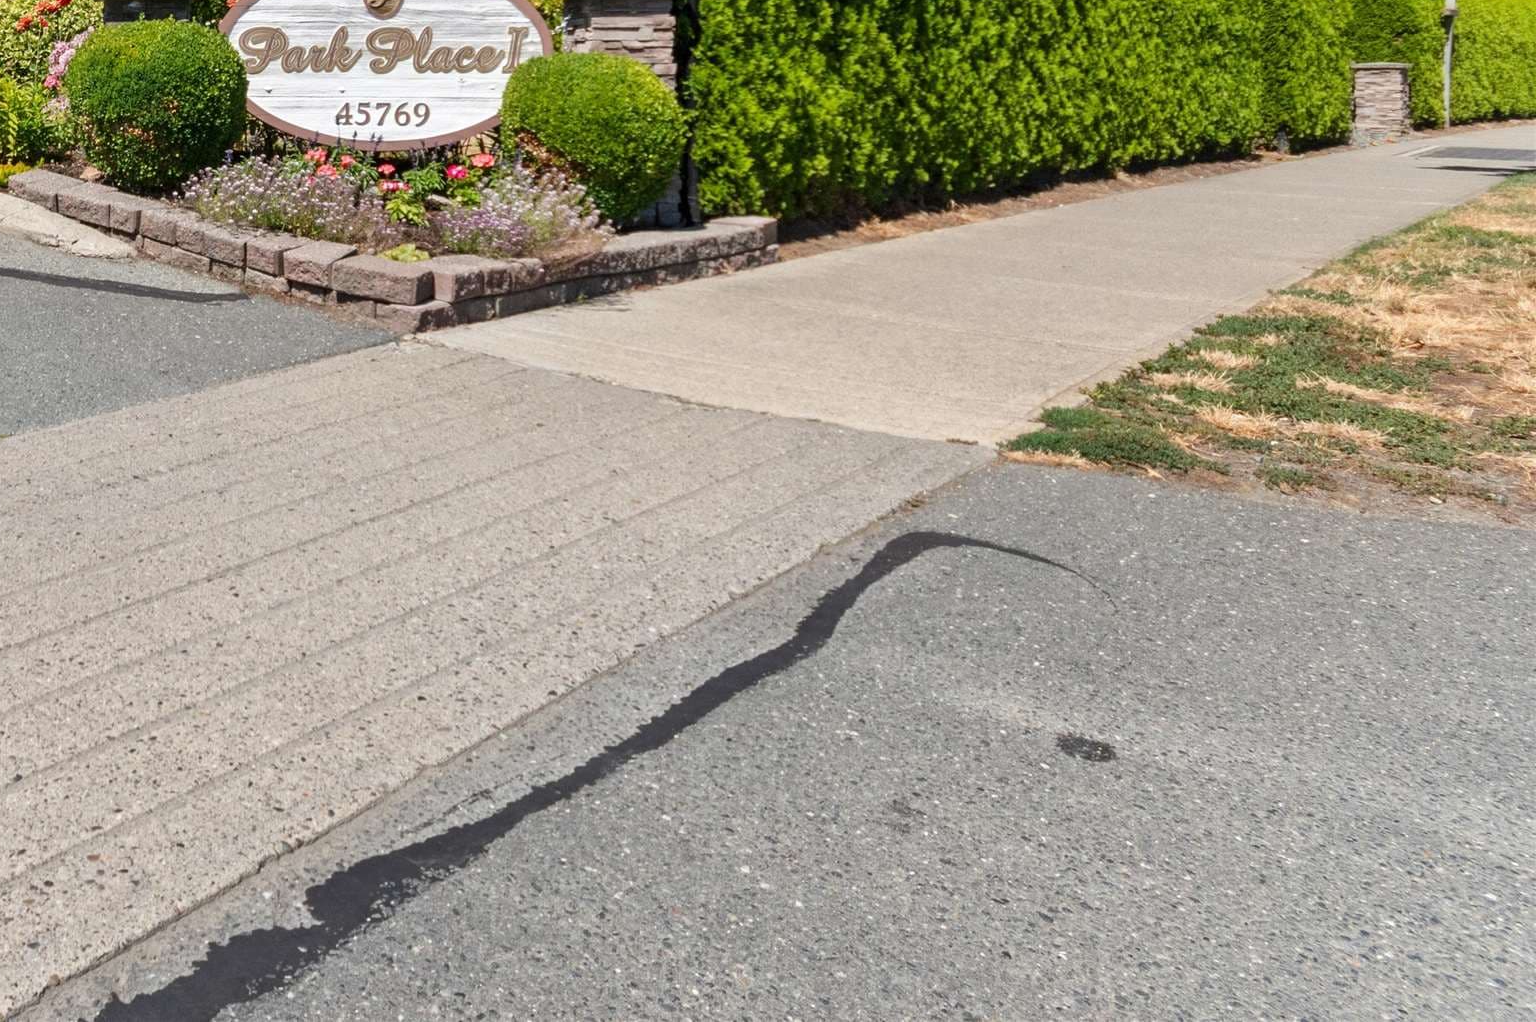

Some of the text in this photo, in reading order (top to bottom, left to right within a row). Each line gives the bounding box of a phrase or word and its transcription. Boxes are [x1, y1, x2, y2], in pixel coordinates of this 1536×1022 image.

[238, 26, 362, 74] Park
[366, 26, 505, 74] Place
[336, 102, 431, 127] 45769
